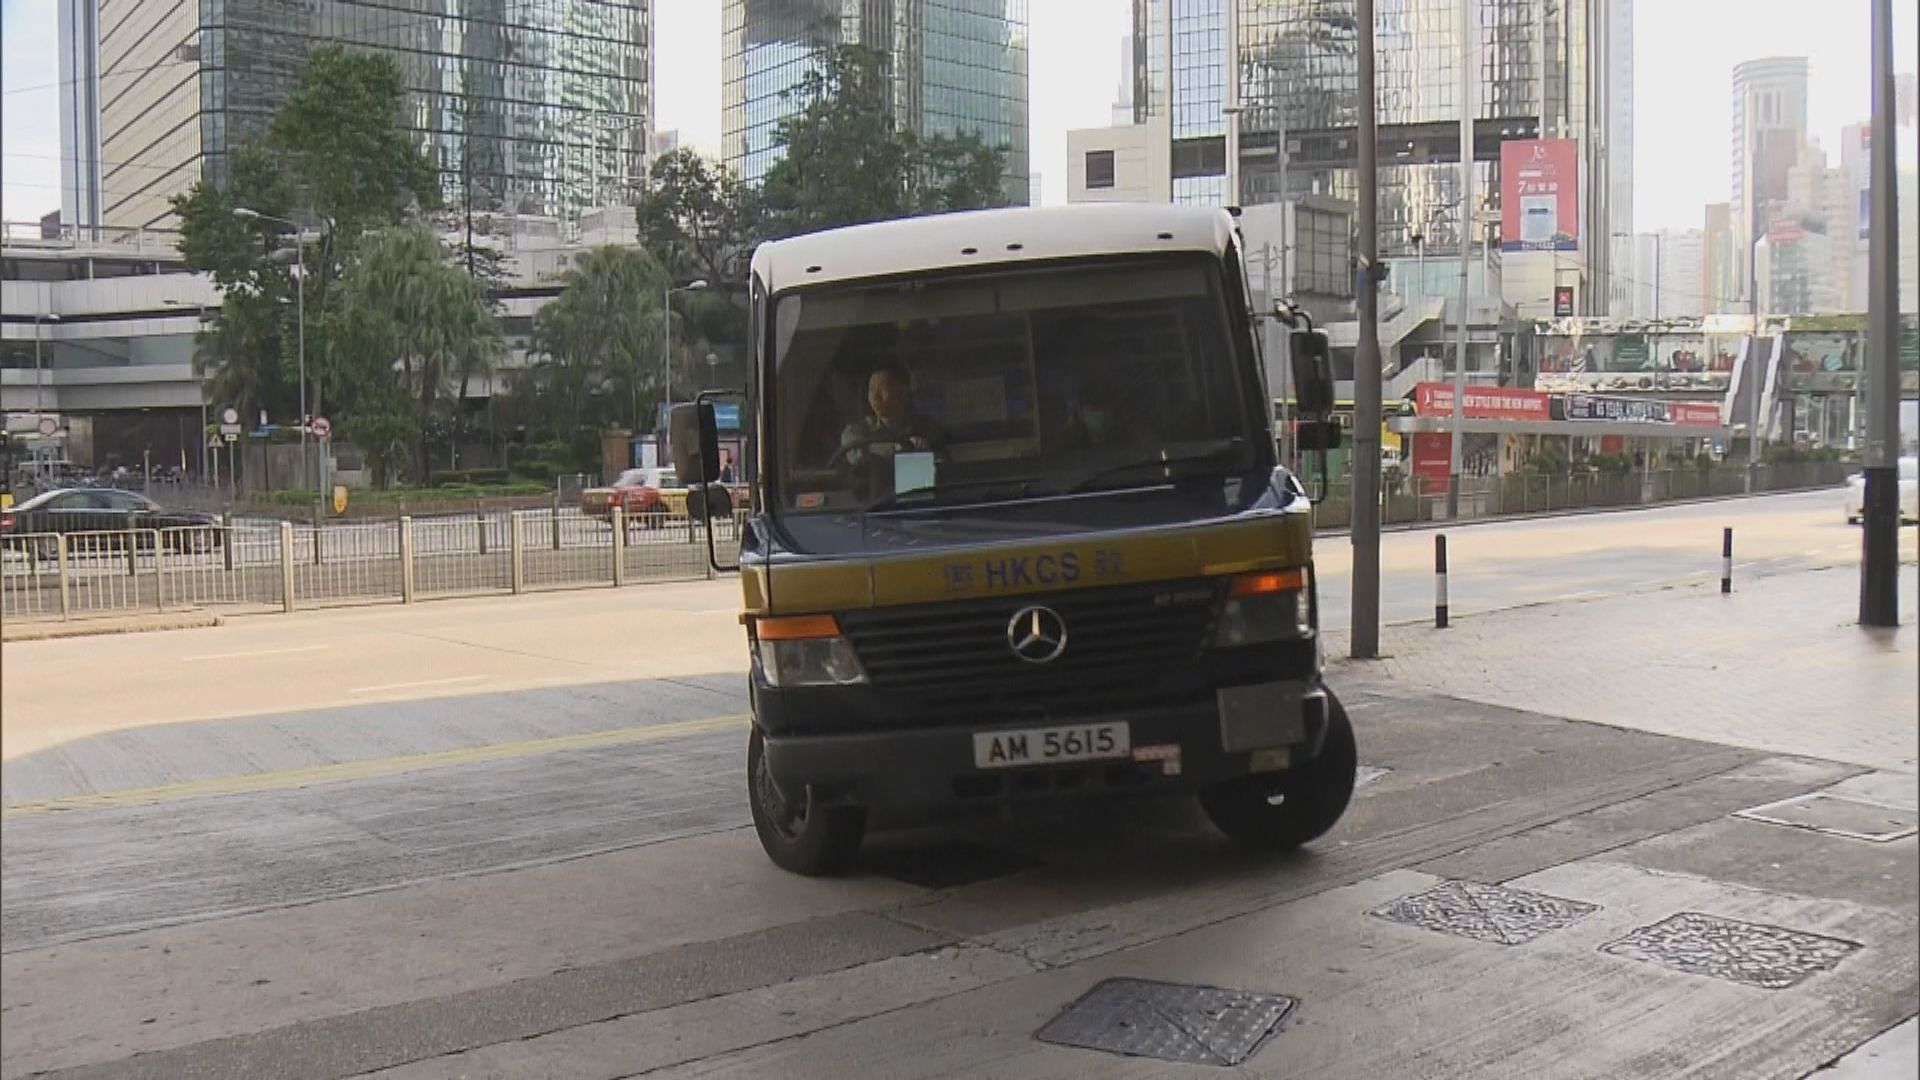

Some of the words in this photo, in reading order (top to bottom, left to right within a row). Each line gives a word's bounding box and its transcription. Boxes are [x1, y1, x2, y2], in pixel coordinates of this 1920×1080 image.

[985, 551, 1080, 589] HKCS
[989, 736, 1029, 763] AM
[1043, 728, 1115, 757] 5615
